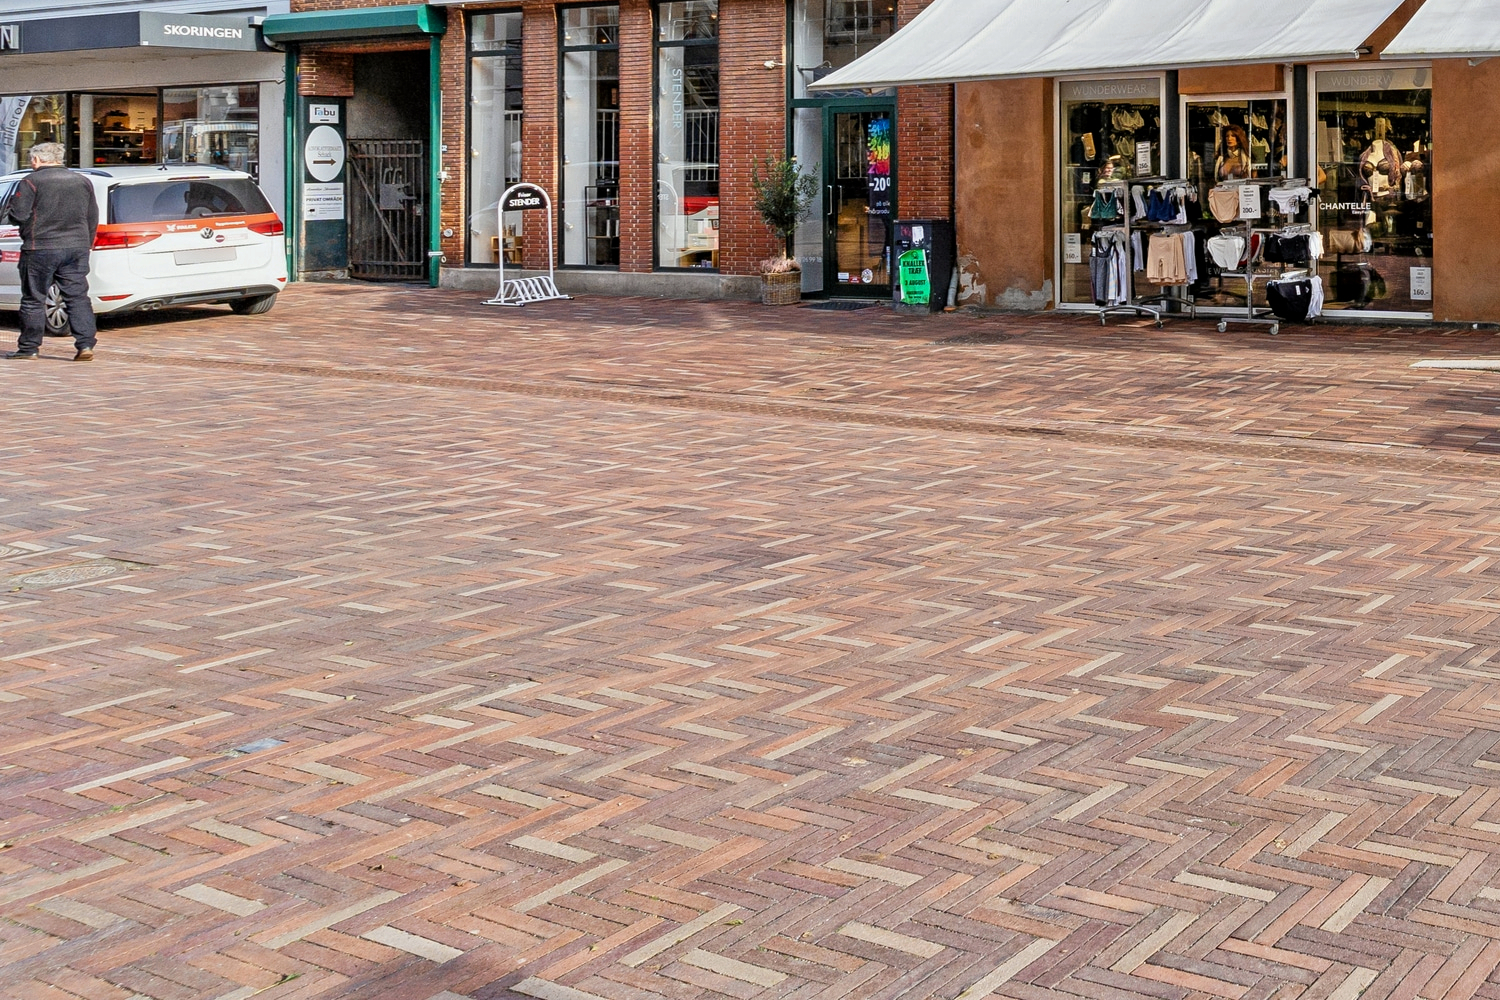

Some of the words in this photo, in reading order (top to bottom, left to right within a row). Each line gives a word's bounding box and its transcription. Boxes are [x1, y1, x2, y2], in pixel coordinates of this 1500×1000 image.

[163, 24, 243, 39] SKORINGEN
[1072, 84, 1148, 96] WUNDERWEAR
[671, 68, 682, 129] STENDER
[509, 198, 540, 207] STENDER
[1319, 202, 1371, 210] CHANTELLE
